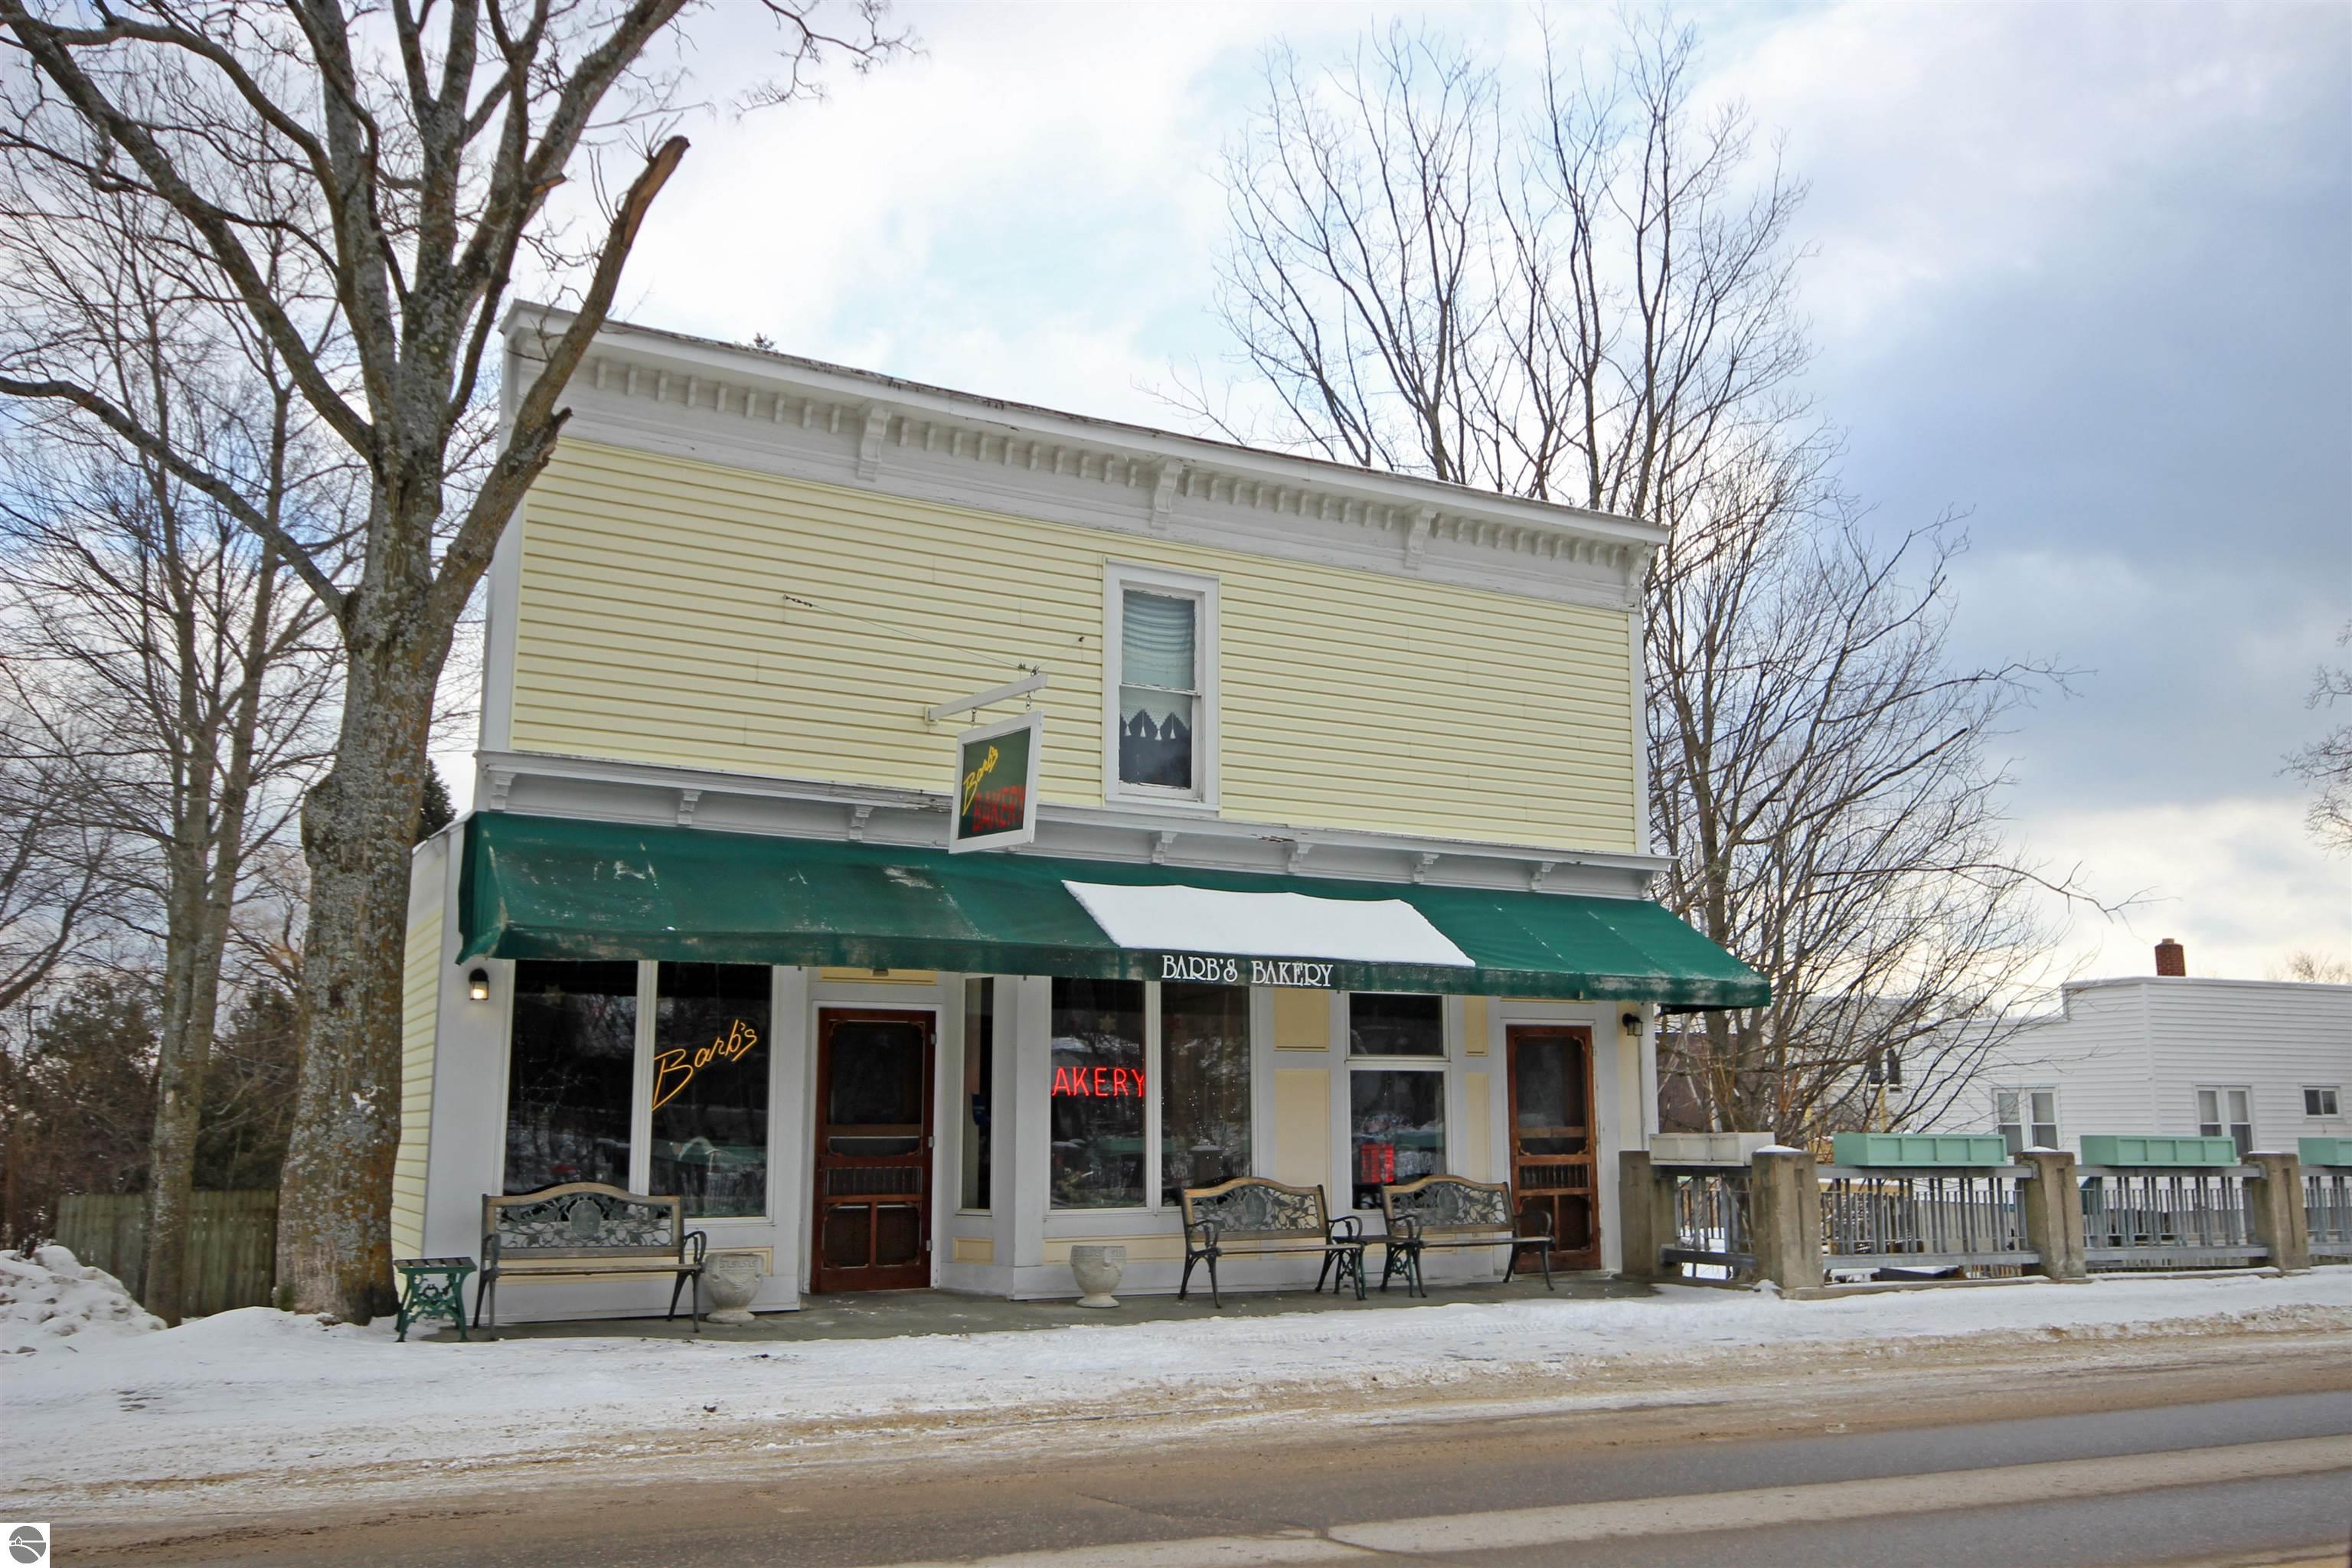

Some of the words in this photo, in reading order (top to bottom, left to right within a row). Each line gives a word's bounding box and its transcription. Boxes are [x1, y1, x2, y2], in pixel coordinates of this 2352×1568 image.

[1161, 955, 1238, 982] BARB'S
[1251, 959, 1334, 987] BAKERY
[652, 1018, 758, 1111] Barb's
[1051, 1065, 1145, 1097] AKERY
